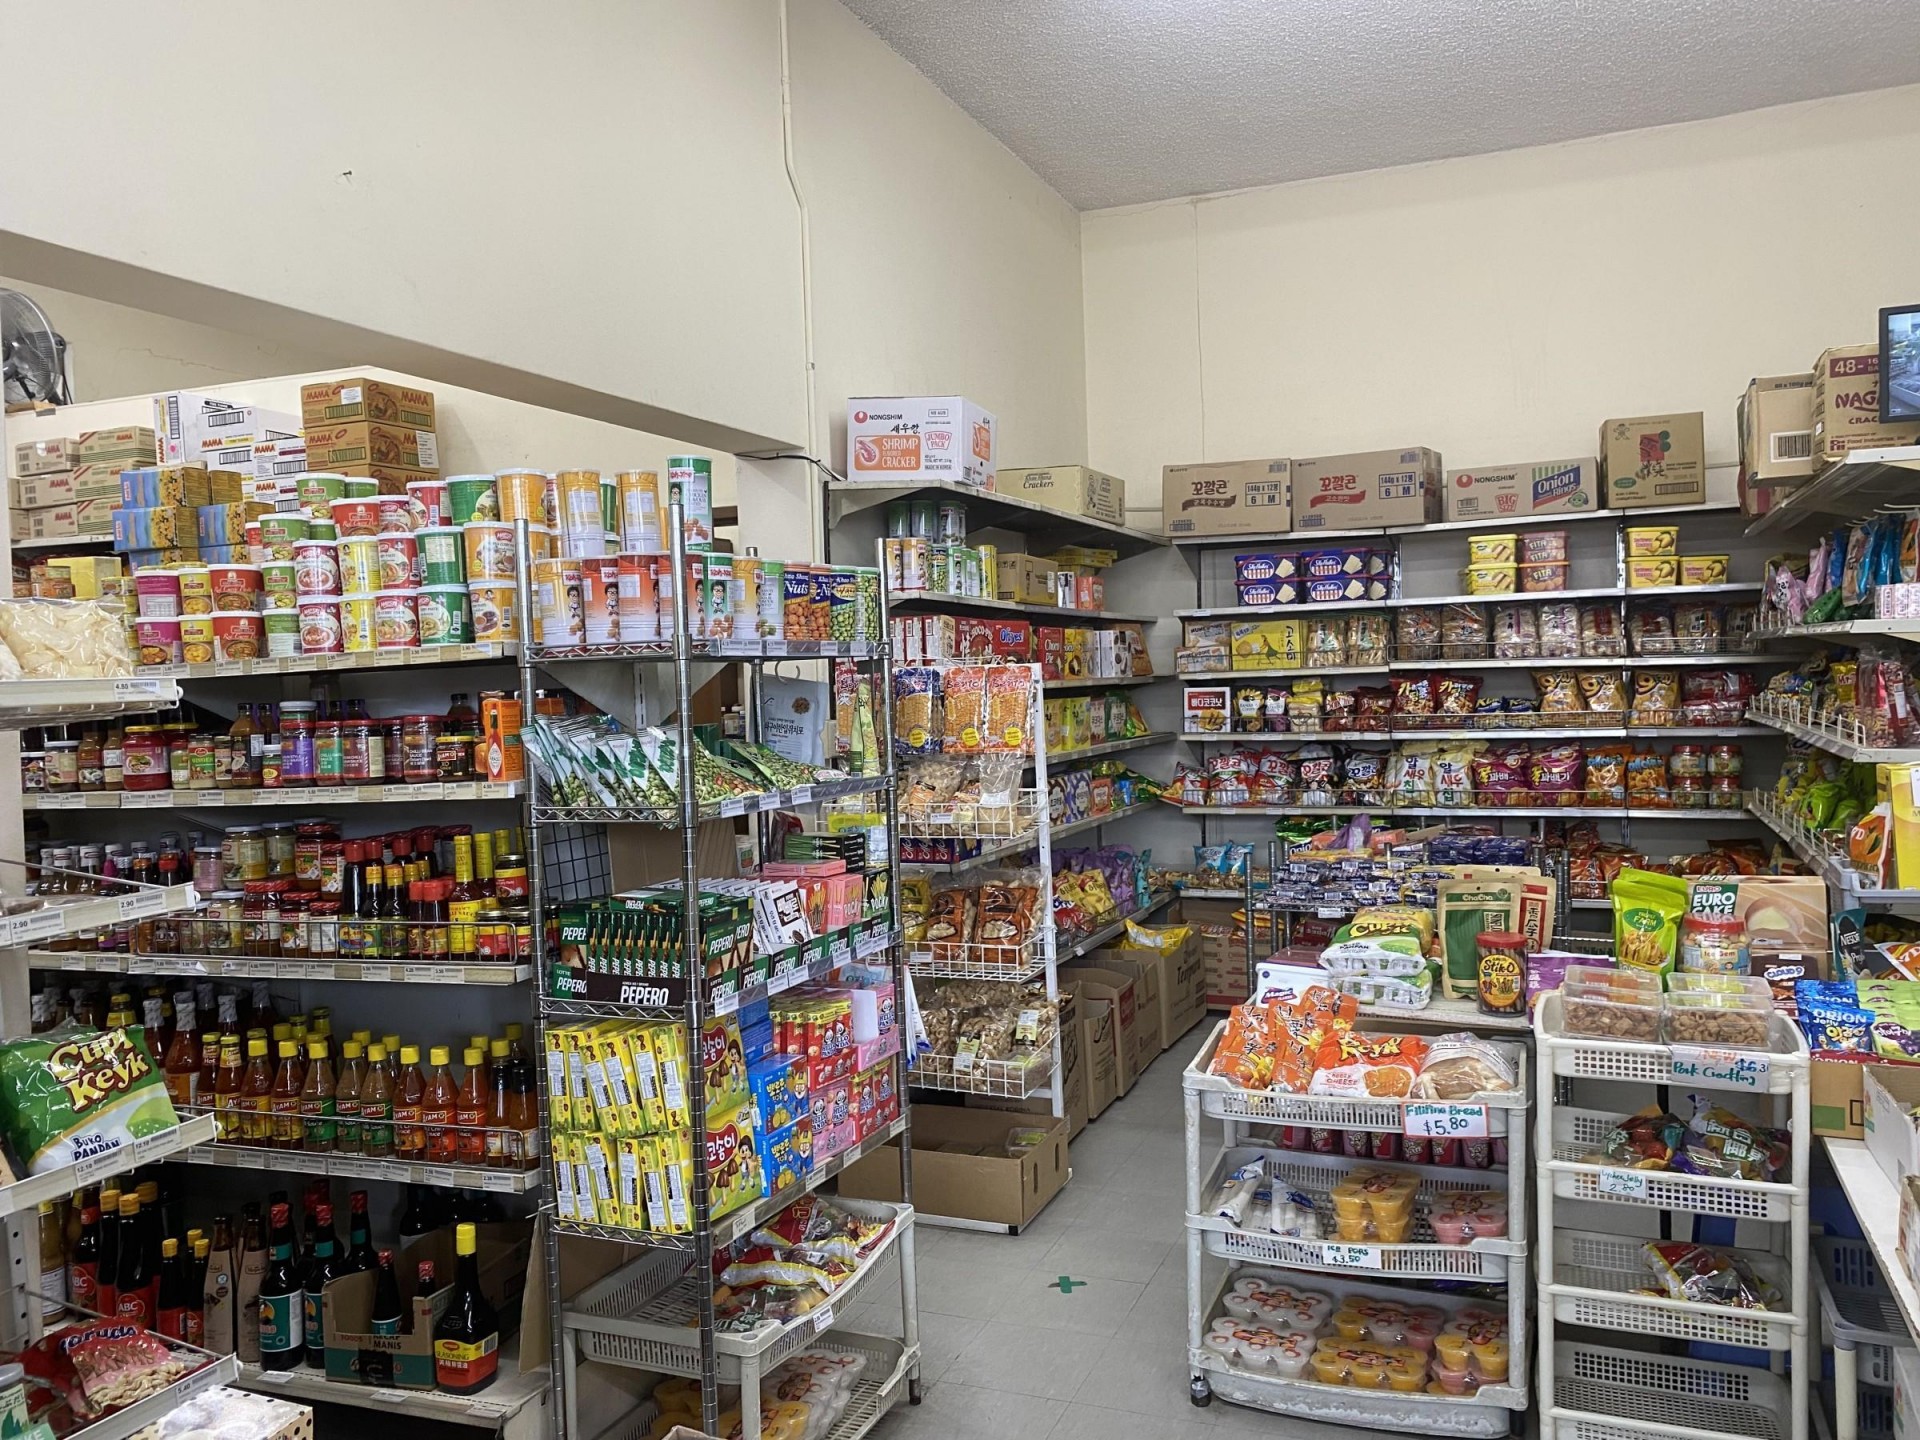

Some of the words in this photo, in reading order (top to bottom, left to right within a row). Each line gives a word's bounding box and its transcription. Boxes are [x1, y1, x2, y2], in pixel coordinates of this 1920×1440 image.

[306, 390, 330, 400] MAMA
[400, 390, 430, 407] MAMA
[1835, 391, 1879, 408] NAG
[1849, 416, 1878, 424] CRAC
[116, 432, 133, 441] MAMA
[308, 434, 332, 444] MAMA
[402, 433, 418, 444] MA
[202, 438, 223, 448] MAMA
[254, 444, 276, 454] MAMA
[882, 438, 918, 450] SHRIMP
[158, 437, 166, 463] MAMA
[882, 456, 916, 468] CRACKER
[50, 478, 70, 488] MAMA
[1023, 480, 1054, 489] Crackers
[1319, 474, 1357, 492] 꼬깔콘
[1474, 474, 1516, 484] NONGSHIM
[1538, 472, 1573, 493] Onion
[256, 481, 277, 492] MAMA
[1191, 480, 1228, 495] 꼬깔콘
[1384, 488, 1390, 497] 6
[1402, 486, 1410, 496] M
[1552, 484, 1577, 496] Rings
[1250, 496, 1256, 506] 6
[1268, 494, 1276, 504] M
[54, 511, 72, 522] MAMA
[1532, 569, 1552, 580] FITA
[784, 580, 808, 594] Nuts
[1290, 844, 1312, 855] Onio
[1462, 894, 1494, 902] ChaCha
[1692, 892, 1736, 906] EURO
[1633, 916, 1657, 926] FARM
[870, 922, 888, 938] PEPERO
[710, 934, 734, 955] PEPERO
[828, 938, 848, 955] PEPERO
[802, 946, 822, 966] PEPERO
[774, 956, 796, 977] PEPERO
[1483, 959, 1515, 973] Stik-O
[742, 968, 766, 990] PEPERO
[1766, 968, 1794, 978] CLOUD
[556, 977, 587, 994] PEPERO
[620, 986, 669, 1007] PEPERO
[1812, 1008, 1866, 1024] ORION
[1812, 1018, 1839, 1027] Jelly
[1673, 1062, 1699, 1077] Pork
[68, 1051, 149, 1112] Keyk
[1448, 1104, 1482, 1116] Bread
[1422, 1116, 1469, 1136] $5.80
[72, 1133, 103, 1149] BUKO
[73, 1139, 121, 1162] PANDAN
[1348, 1247, 1369, 1256] POPS
[119, 1301, 138, 1311] ABC
[374, 1341, 402, 1350] MANIS
